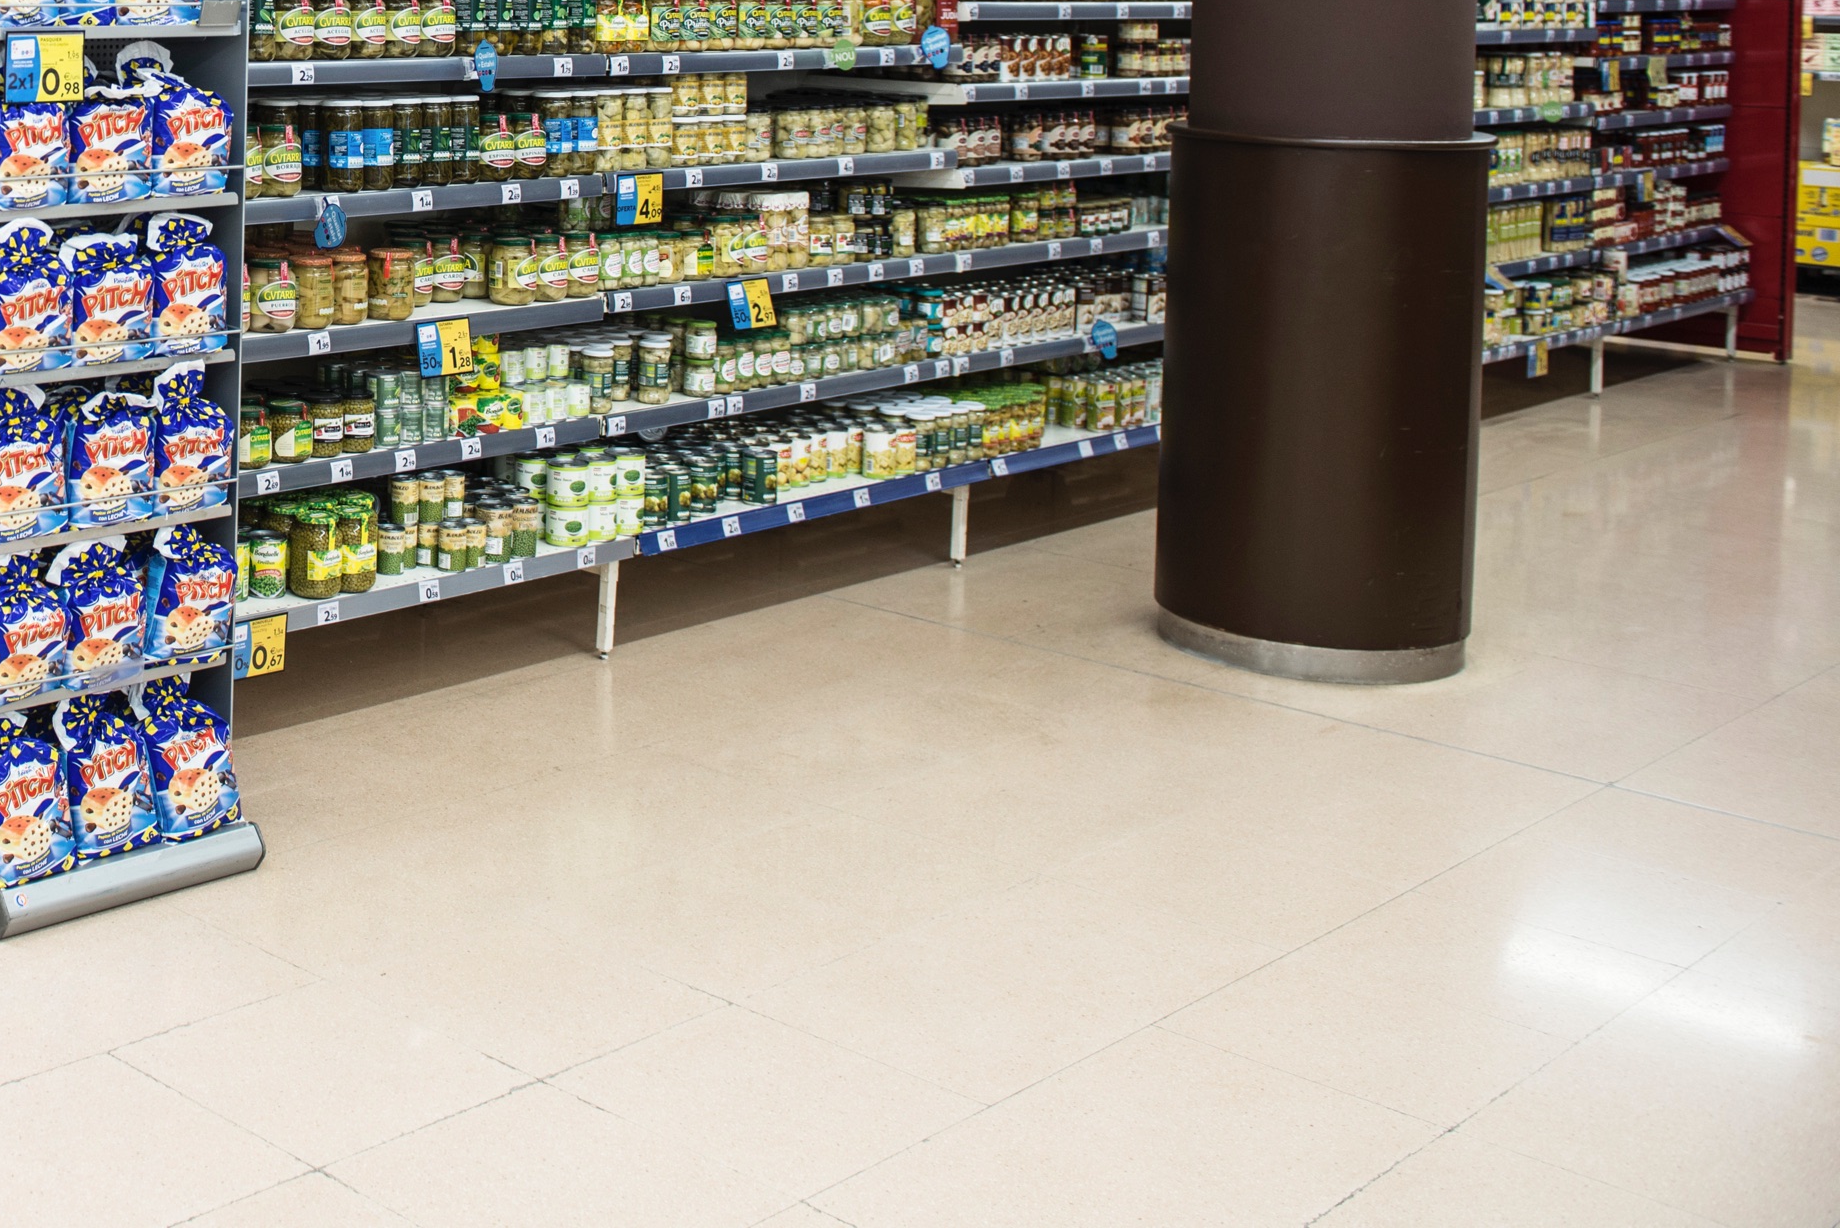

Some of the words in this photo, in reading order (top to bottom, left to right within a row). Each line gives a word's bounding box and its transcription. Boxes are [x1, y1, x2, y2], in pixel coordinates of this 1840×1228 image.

[835, 50, 855, 63] NOU
[8, 72, 34, 90] 2x1
[254, 546, 279, 557] Bonduelle
